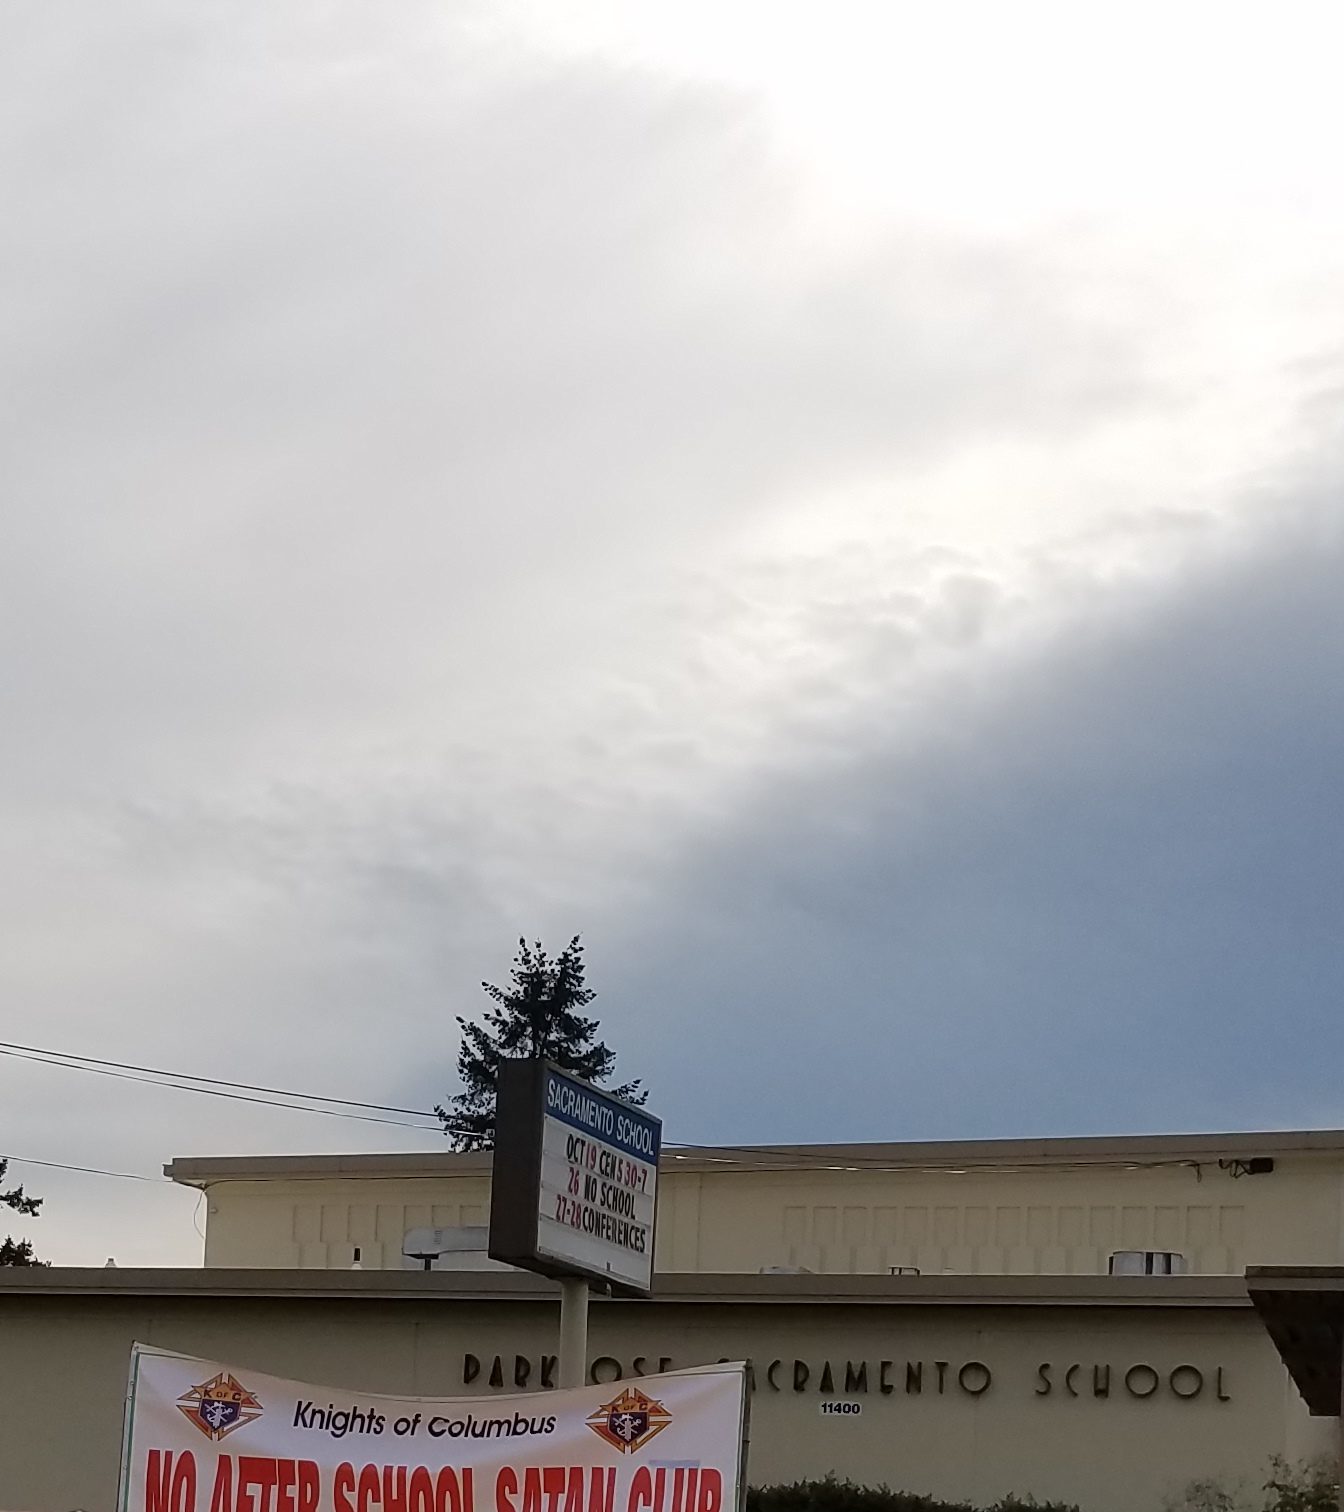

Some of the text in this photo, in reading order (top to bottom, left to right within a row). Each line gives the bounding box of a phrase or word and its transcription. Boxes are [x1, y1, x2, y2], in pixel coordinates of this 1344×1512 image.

[547, 1078, 654, 1156] SACRAMENTO SCHOOL
[568, 1167, 636, 1220] 26 NO SCHOOL
[556, 1194, 646, 1253] 27-28 CONFERENCES
[203, 1389, 213, 1399] K
[231, 1392, 242, 1401] C
[1035, 1363, 1231, 1401] SCHOOL
[293, 1400, 557, 1438] Knights of Columbus
[821, 1402, 861, 1414] 11400
